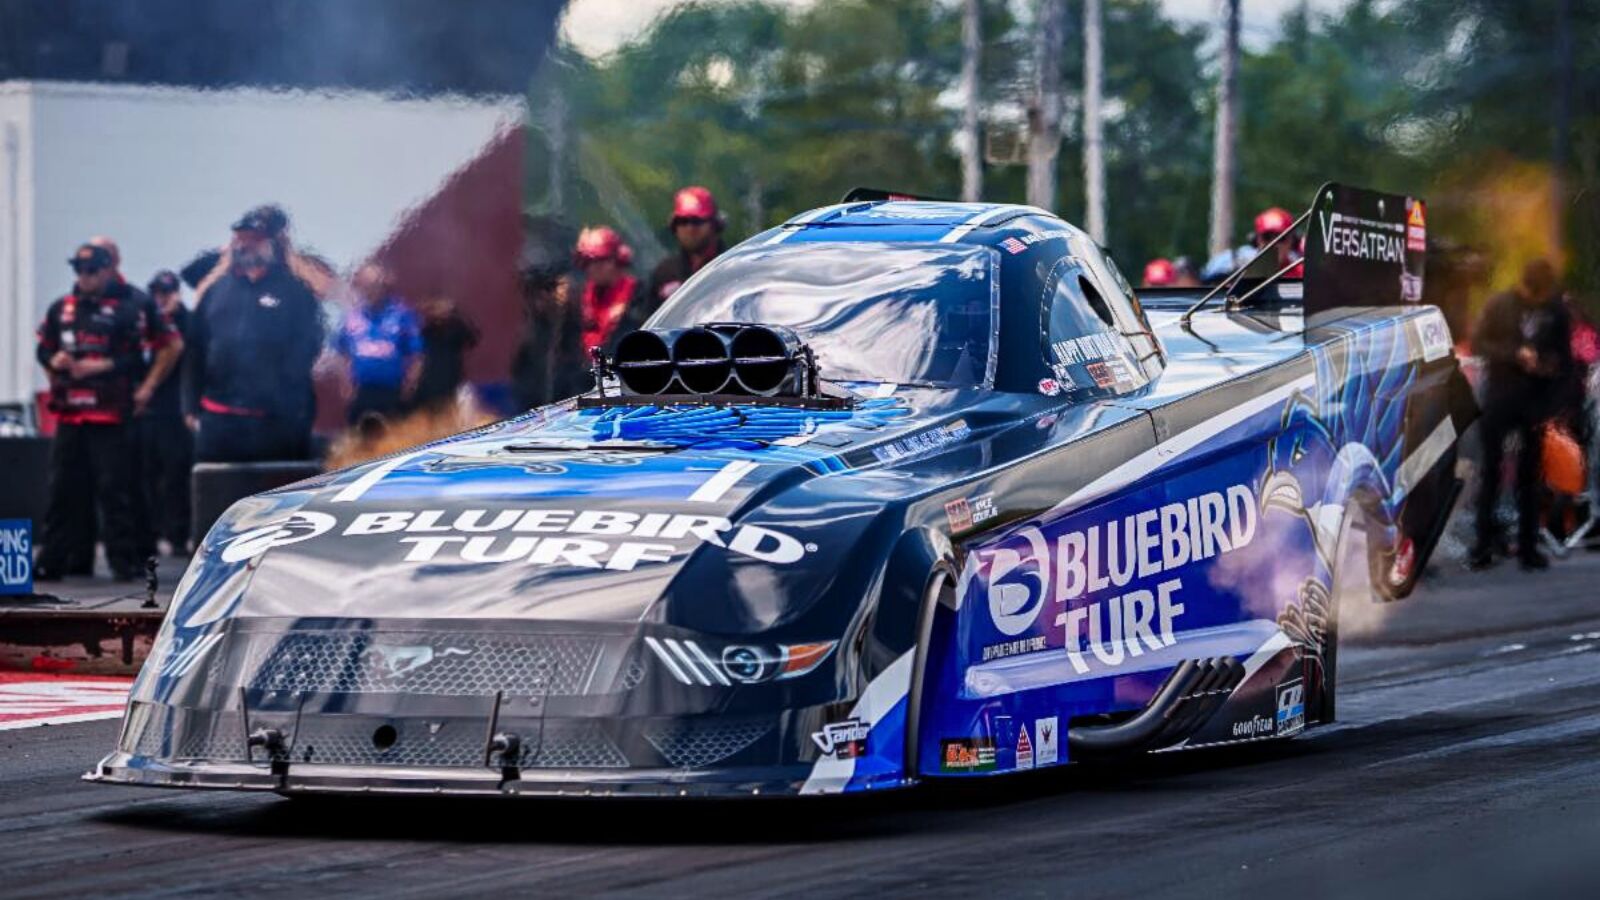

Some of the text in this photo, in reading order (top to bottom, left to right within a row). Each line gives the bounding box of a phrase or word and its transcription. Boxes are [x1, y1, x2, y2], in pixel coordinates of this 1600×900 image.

[1319, 210, 1405, 263] VERSATRAN
[400, 536, 675, 571] TURF
[1055, 484, 1257, 602] BLUEBIRD
[1054, 578, 1185, 674] TURF
